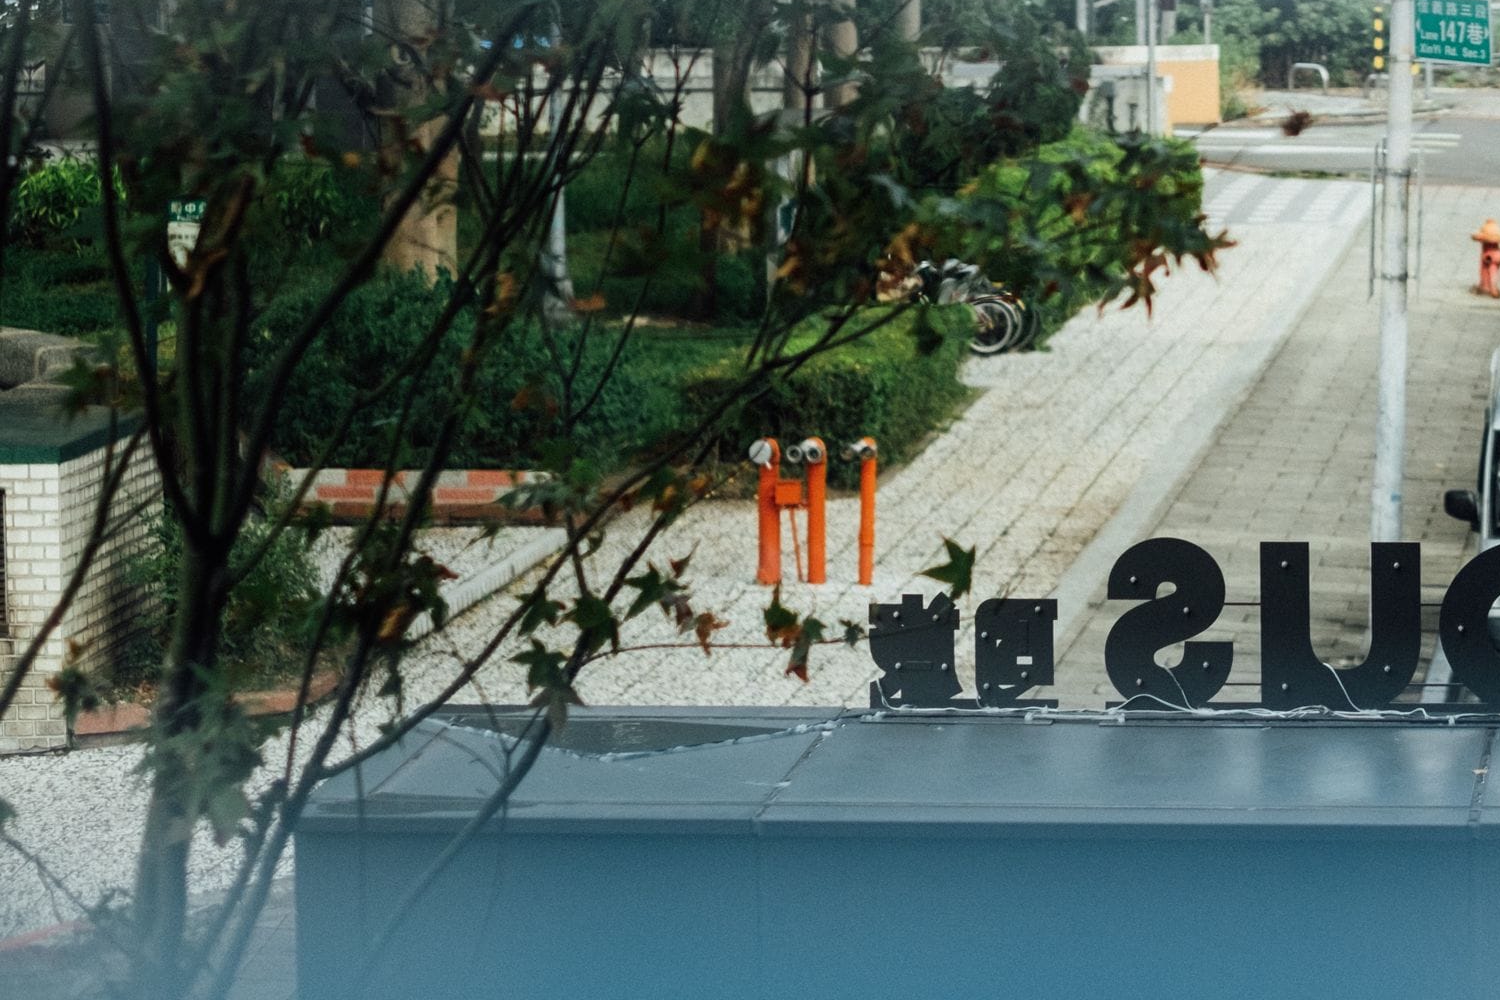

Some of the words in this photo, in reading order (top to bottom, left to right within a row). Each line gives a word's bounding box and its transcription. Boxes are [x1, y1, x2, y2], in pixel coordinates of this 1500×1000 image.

[1417, 0, 1487, 19] 信義路三段
